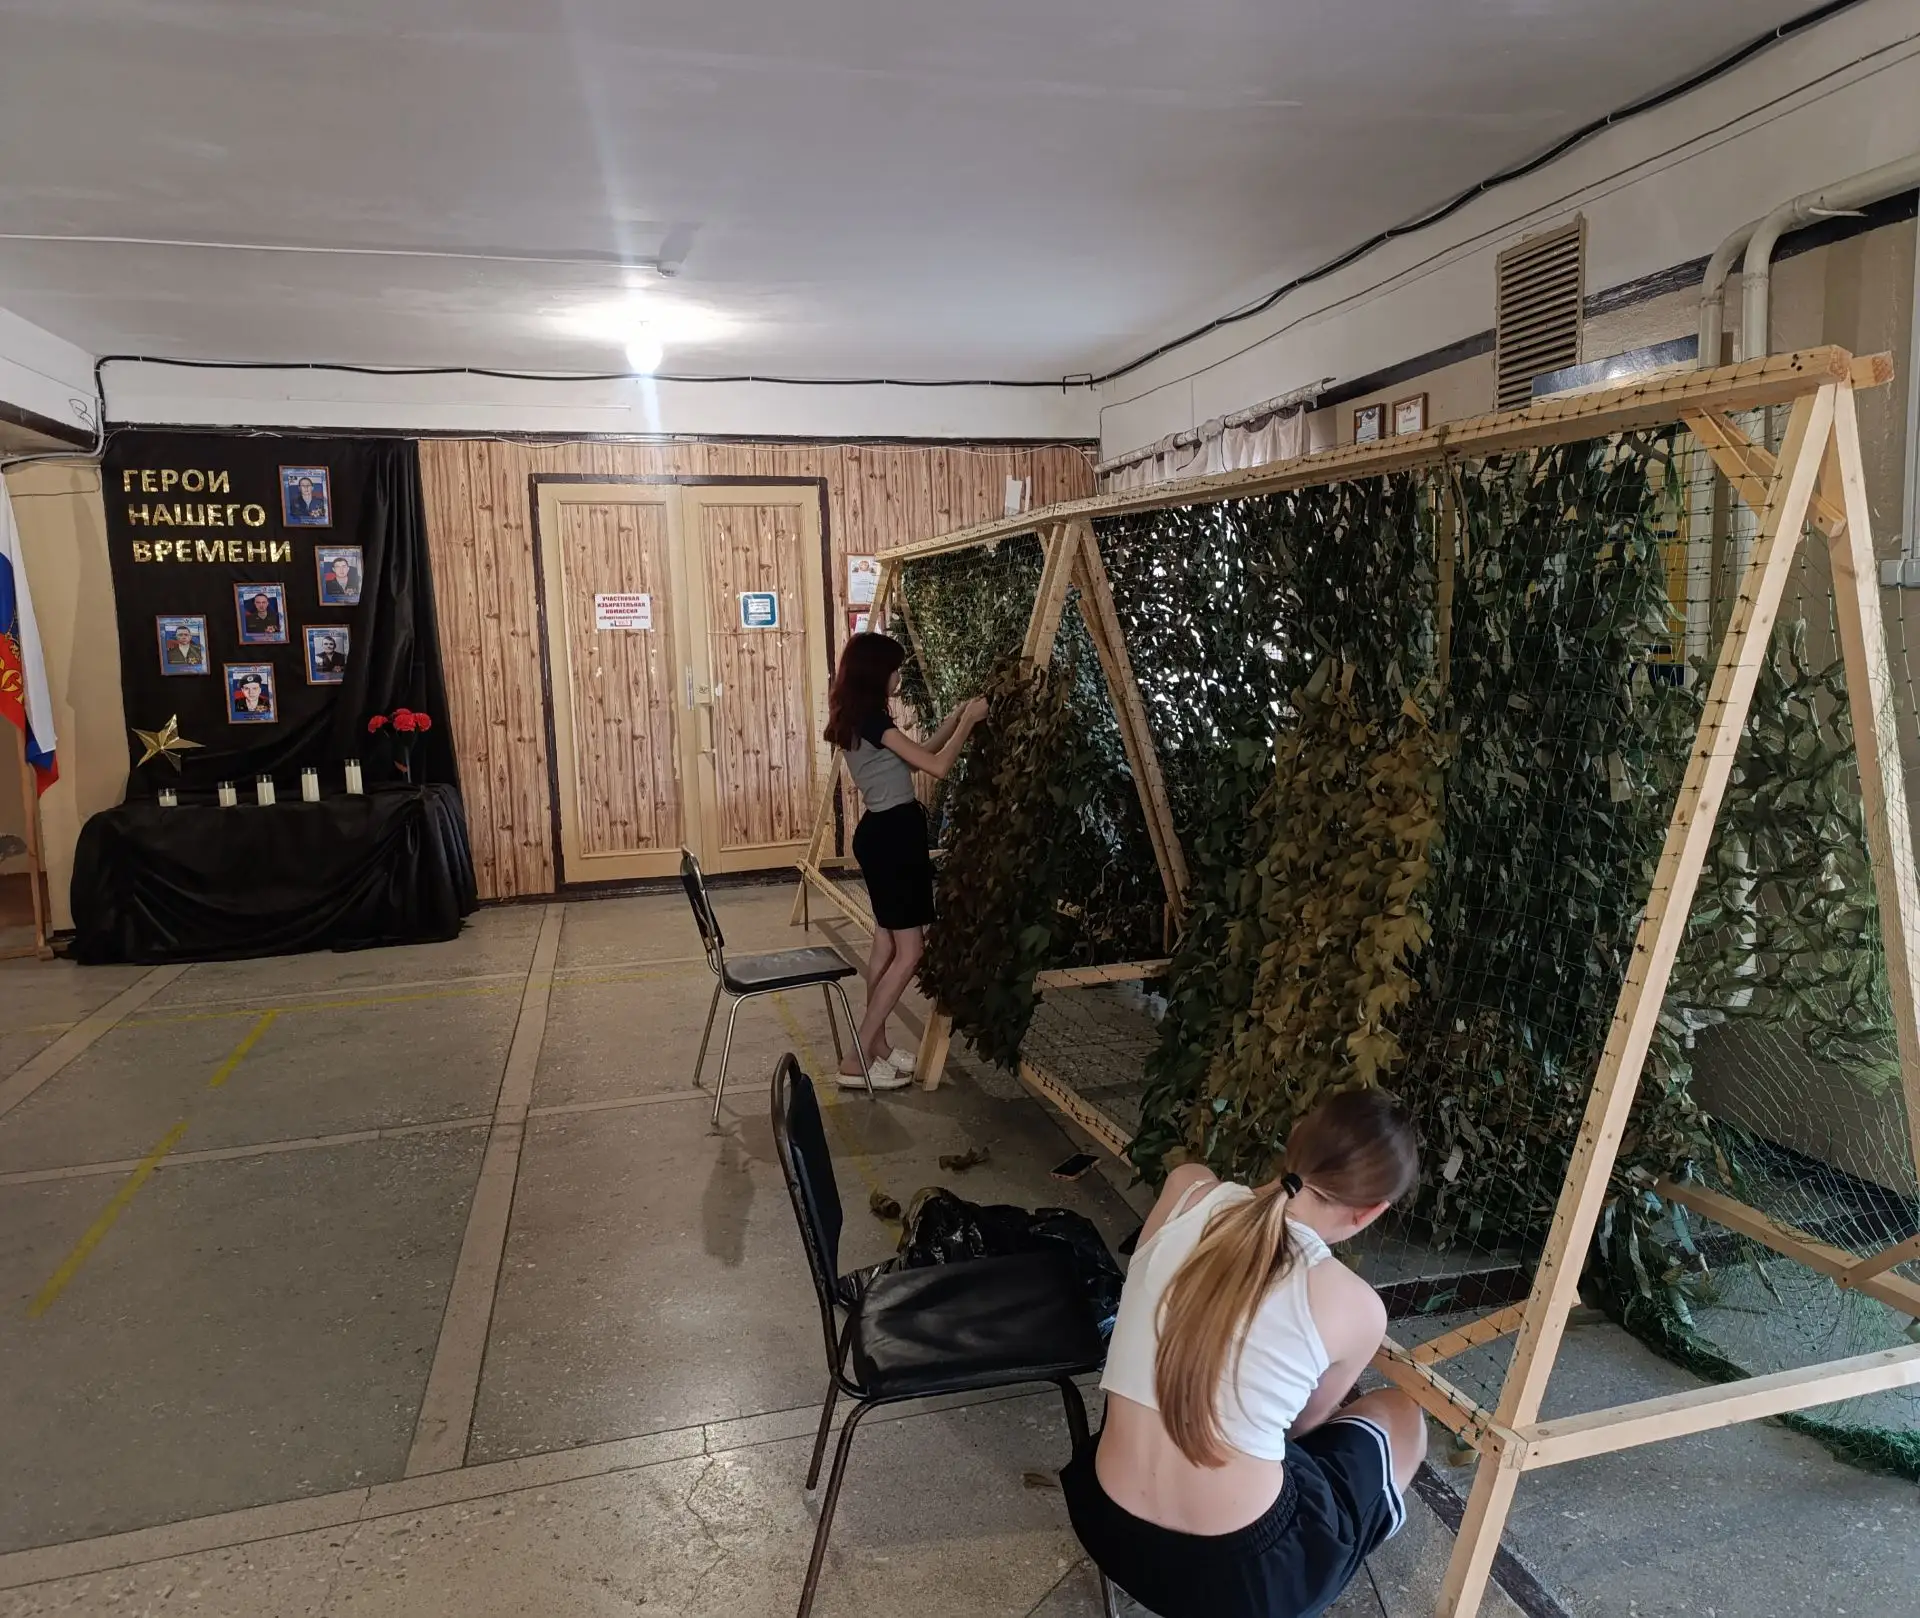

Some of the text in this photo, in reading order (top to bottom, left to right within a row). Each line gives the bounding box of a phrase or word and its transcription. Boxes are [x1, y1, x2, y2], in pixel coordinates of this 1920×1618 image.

[122, 469, 230, 493] ГЕРОИ
[128, 503, 266, 527] НАШЕГО
[132, 540, 292, 563] ВРЕМЕНИ
